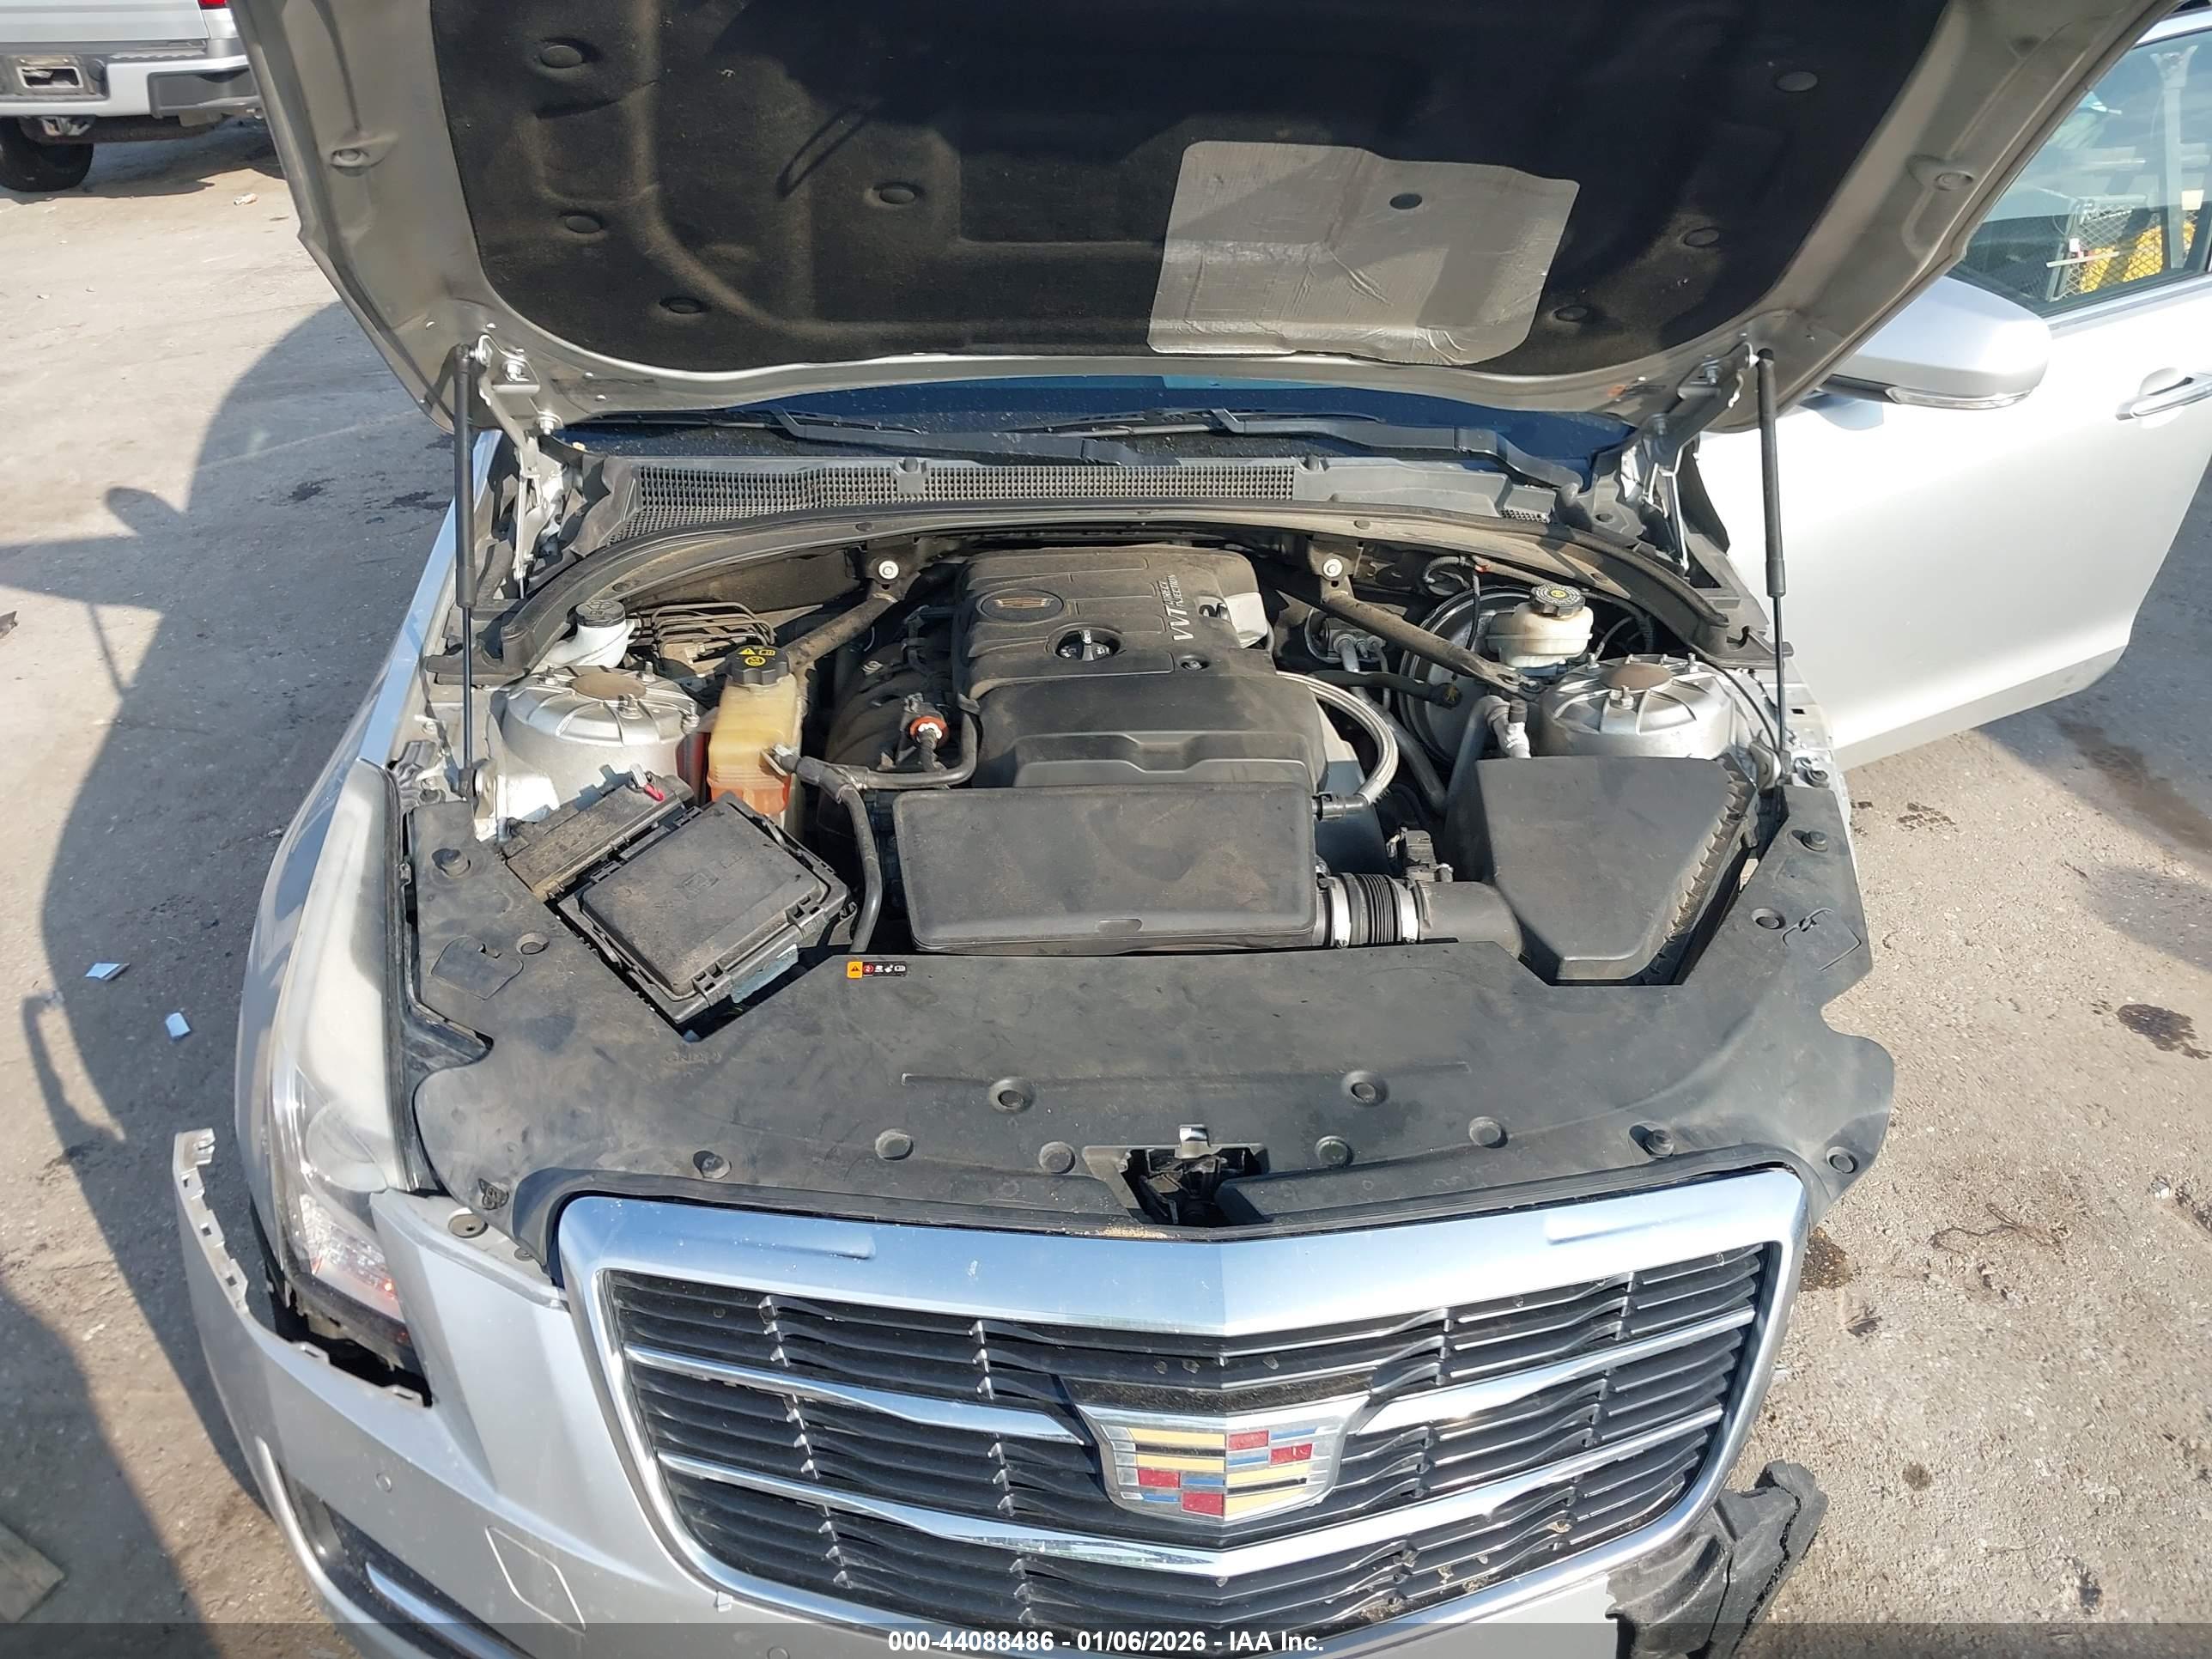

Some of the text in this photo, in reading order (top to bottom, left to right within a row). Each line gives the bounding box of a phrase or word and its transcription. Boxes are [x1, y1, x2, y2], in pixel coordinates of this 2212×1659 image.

[1159, 581, 1173, 605] DIRECT
[1168, 574, 1184, 606] INJECTION
[1164, 605, 1194, 640] VVT
